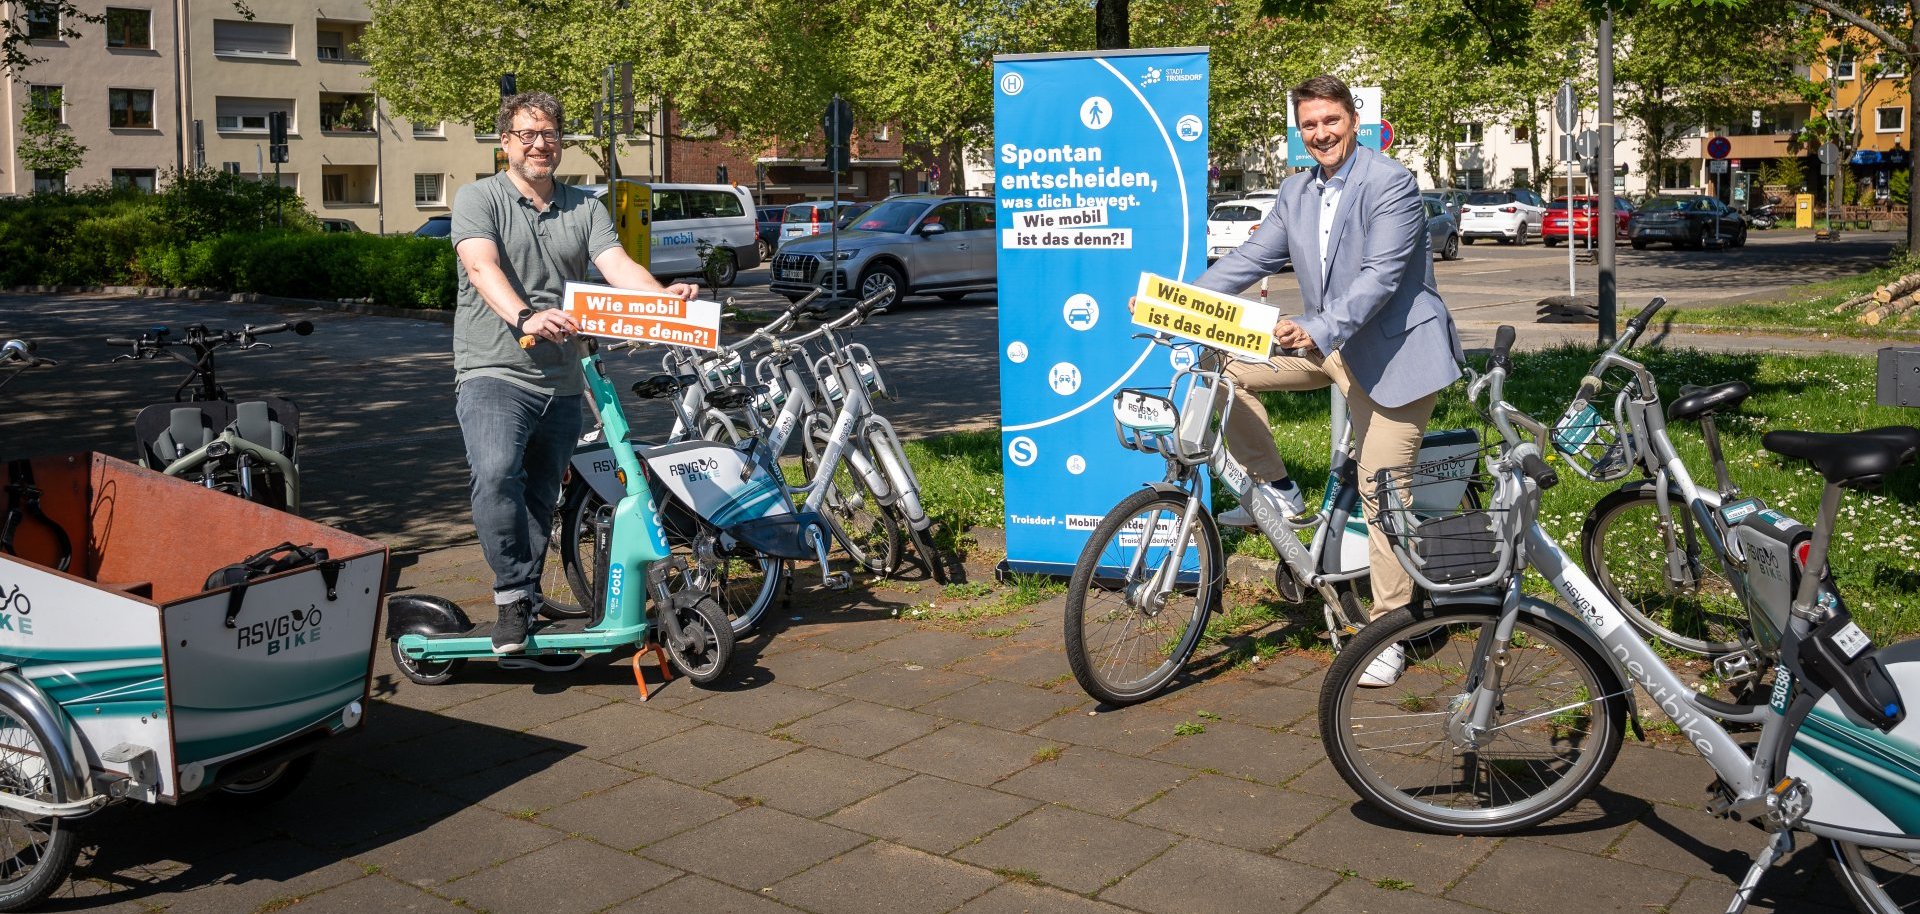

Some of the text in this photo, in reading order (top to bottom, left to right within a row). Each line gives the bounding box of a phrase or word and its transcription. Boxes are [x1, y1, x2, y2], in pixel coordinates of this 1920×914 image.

[1165, 73, 1203, 82] TROISDORF
[1001, 143, 1102, 169] Spontan
[1001, 166, 1157, 192] entscheiden,
[1001, 193, 1140, 211] was dich bewegt.
[1024, 209, 1101, 228] Wie mobil
[663, 231, 694, 246] mobil
[1017, 232, 1125, 246] ist das denn?!
[586, 295, 680, 316] Wie mobil
[1157, 282, 1237, 323] Wie mobil
[581, 315, 709, 345] ist das denn?!
[1148, 307, 1262, 351] ist das denn?!
[593, 459, 618, 473] RSV
[669, 461, 700, 476] RSVG
[688, 469, 720, 482] BIKE
[1010, 515, 1056, 526] Troisdorf
[1252, 497, 1299, 560] nextbike
[611, 568, 622, 595] dott
[1759, 563, 1783, 581] BIKE
[1563, 580, 1590, 611] RSVG
[0, 612, 33, 636] KE
[237, 614, 290, 650] RSVG
[267, 627, 322, 656] BIKE
[1613, 643, 1714, 757] nextbike
